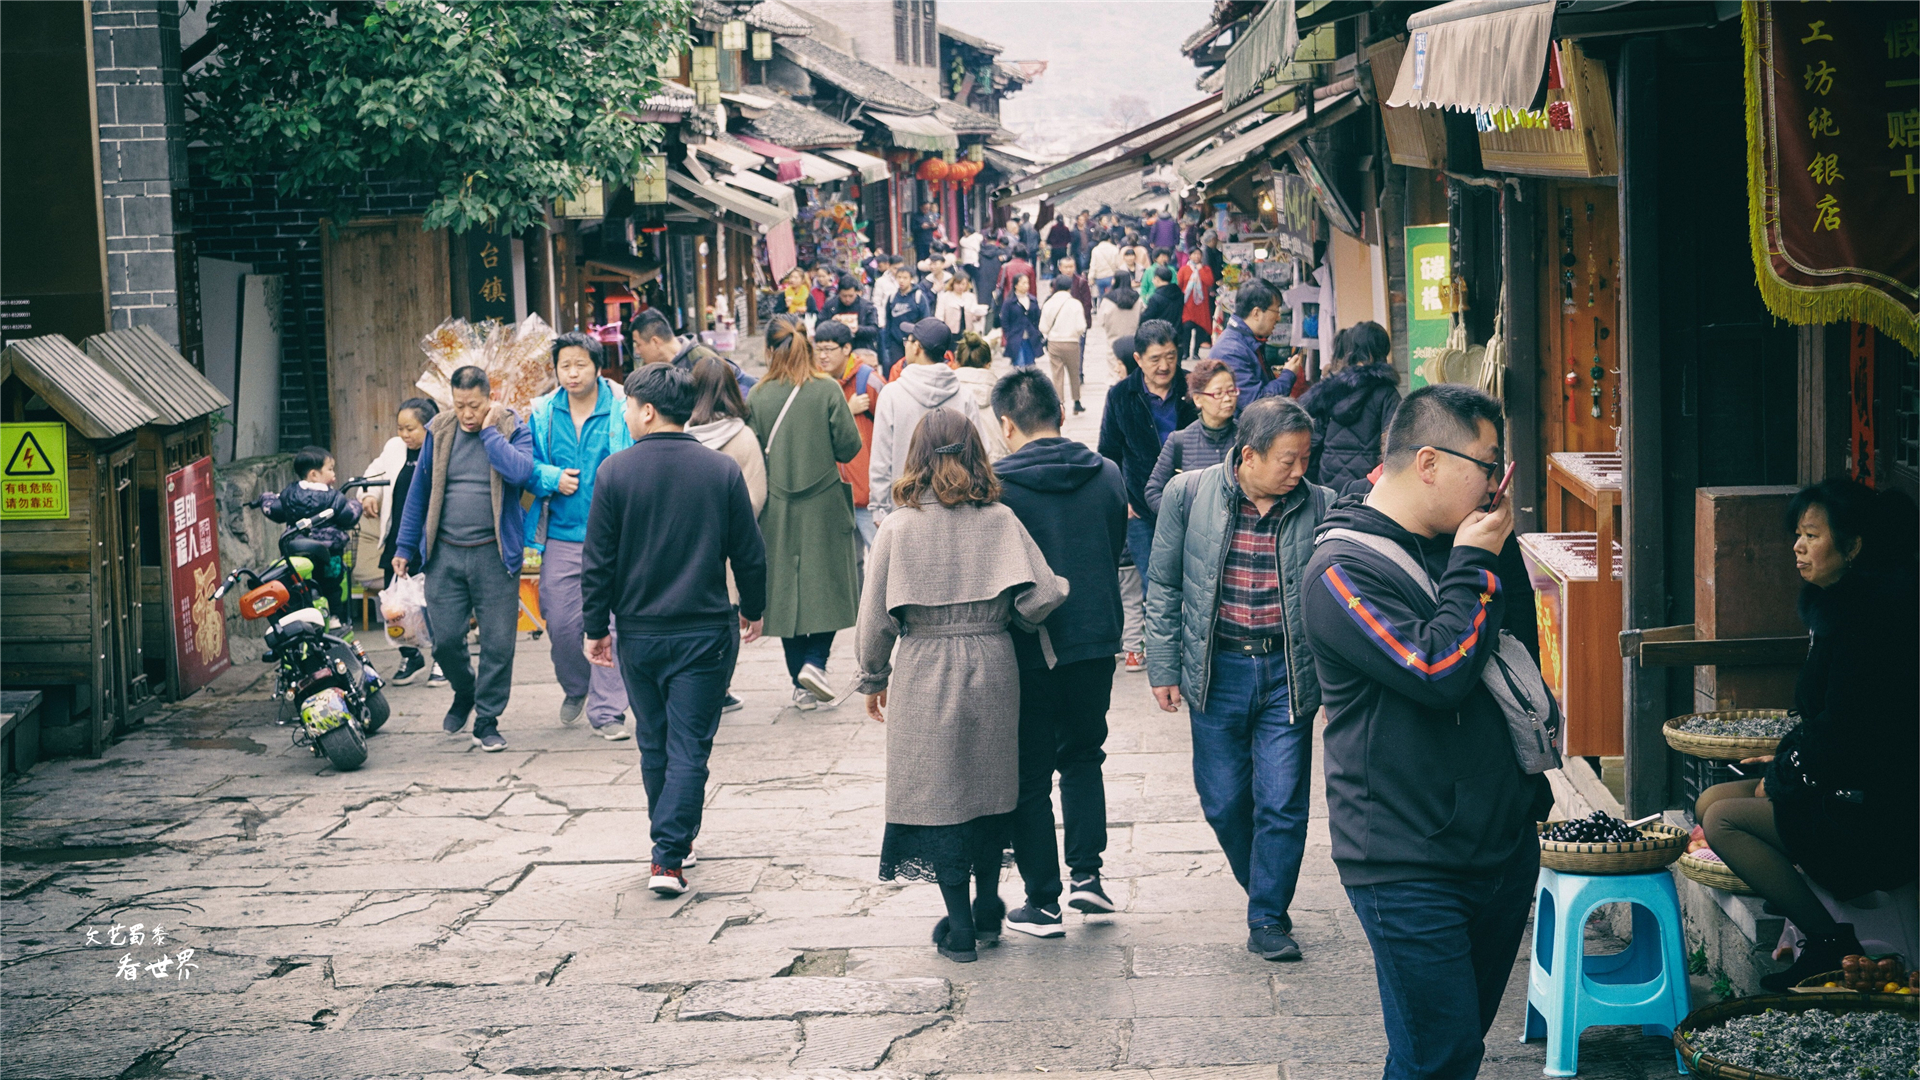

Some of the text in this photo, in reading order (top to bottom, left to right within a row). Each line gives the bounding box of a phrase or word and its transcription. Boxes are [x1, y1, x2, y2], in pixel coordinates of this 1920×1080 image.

[1800, 0, 1845, 233] 工坊纯银店
[479, 214, 507, 326] 台镇
[5, 482, 58, 494] 有电危险！
[5, 497, 59, 509] 请勿靠近！
